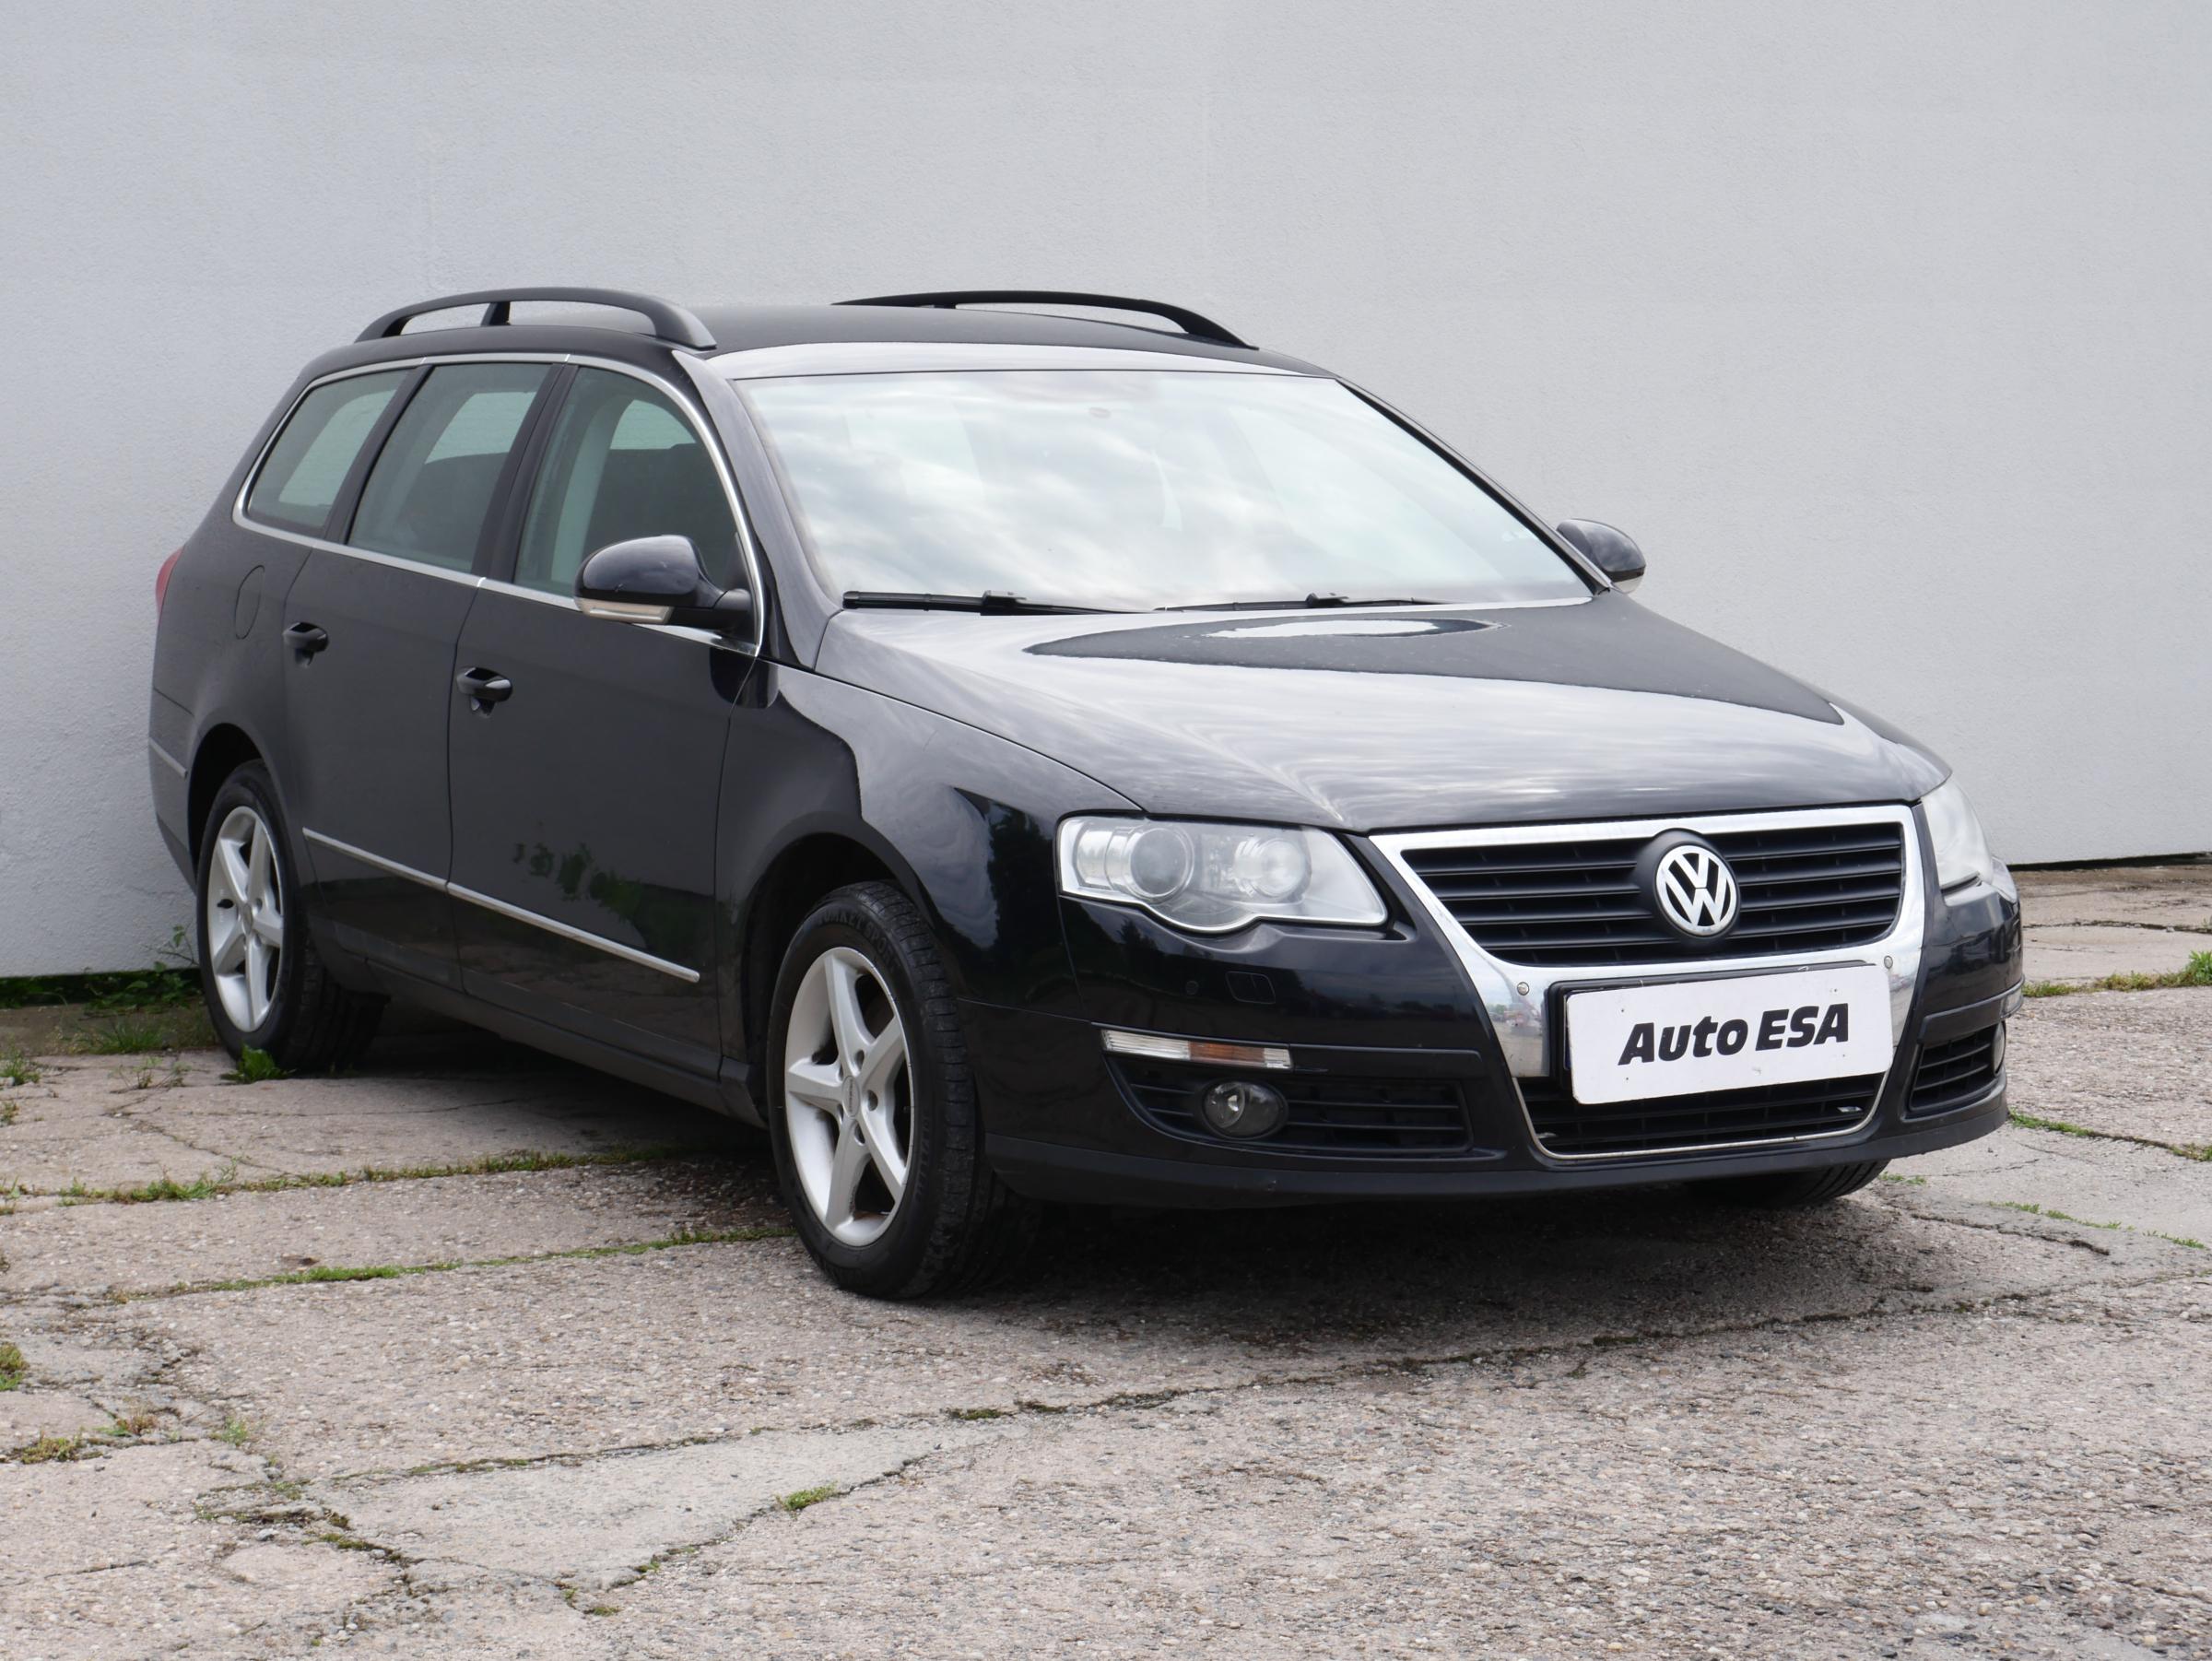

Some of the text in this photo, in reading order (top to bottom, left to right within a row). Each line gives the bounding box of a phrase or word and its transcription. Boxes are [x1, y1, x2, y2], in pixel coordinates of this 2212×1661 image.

[1655, 844, 1737, 937] VW
[1618, 1003, 1849, 1066] Auto ESA
